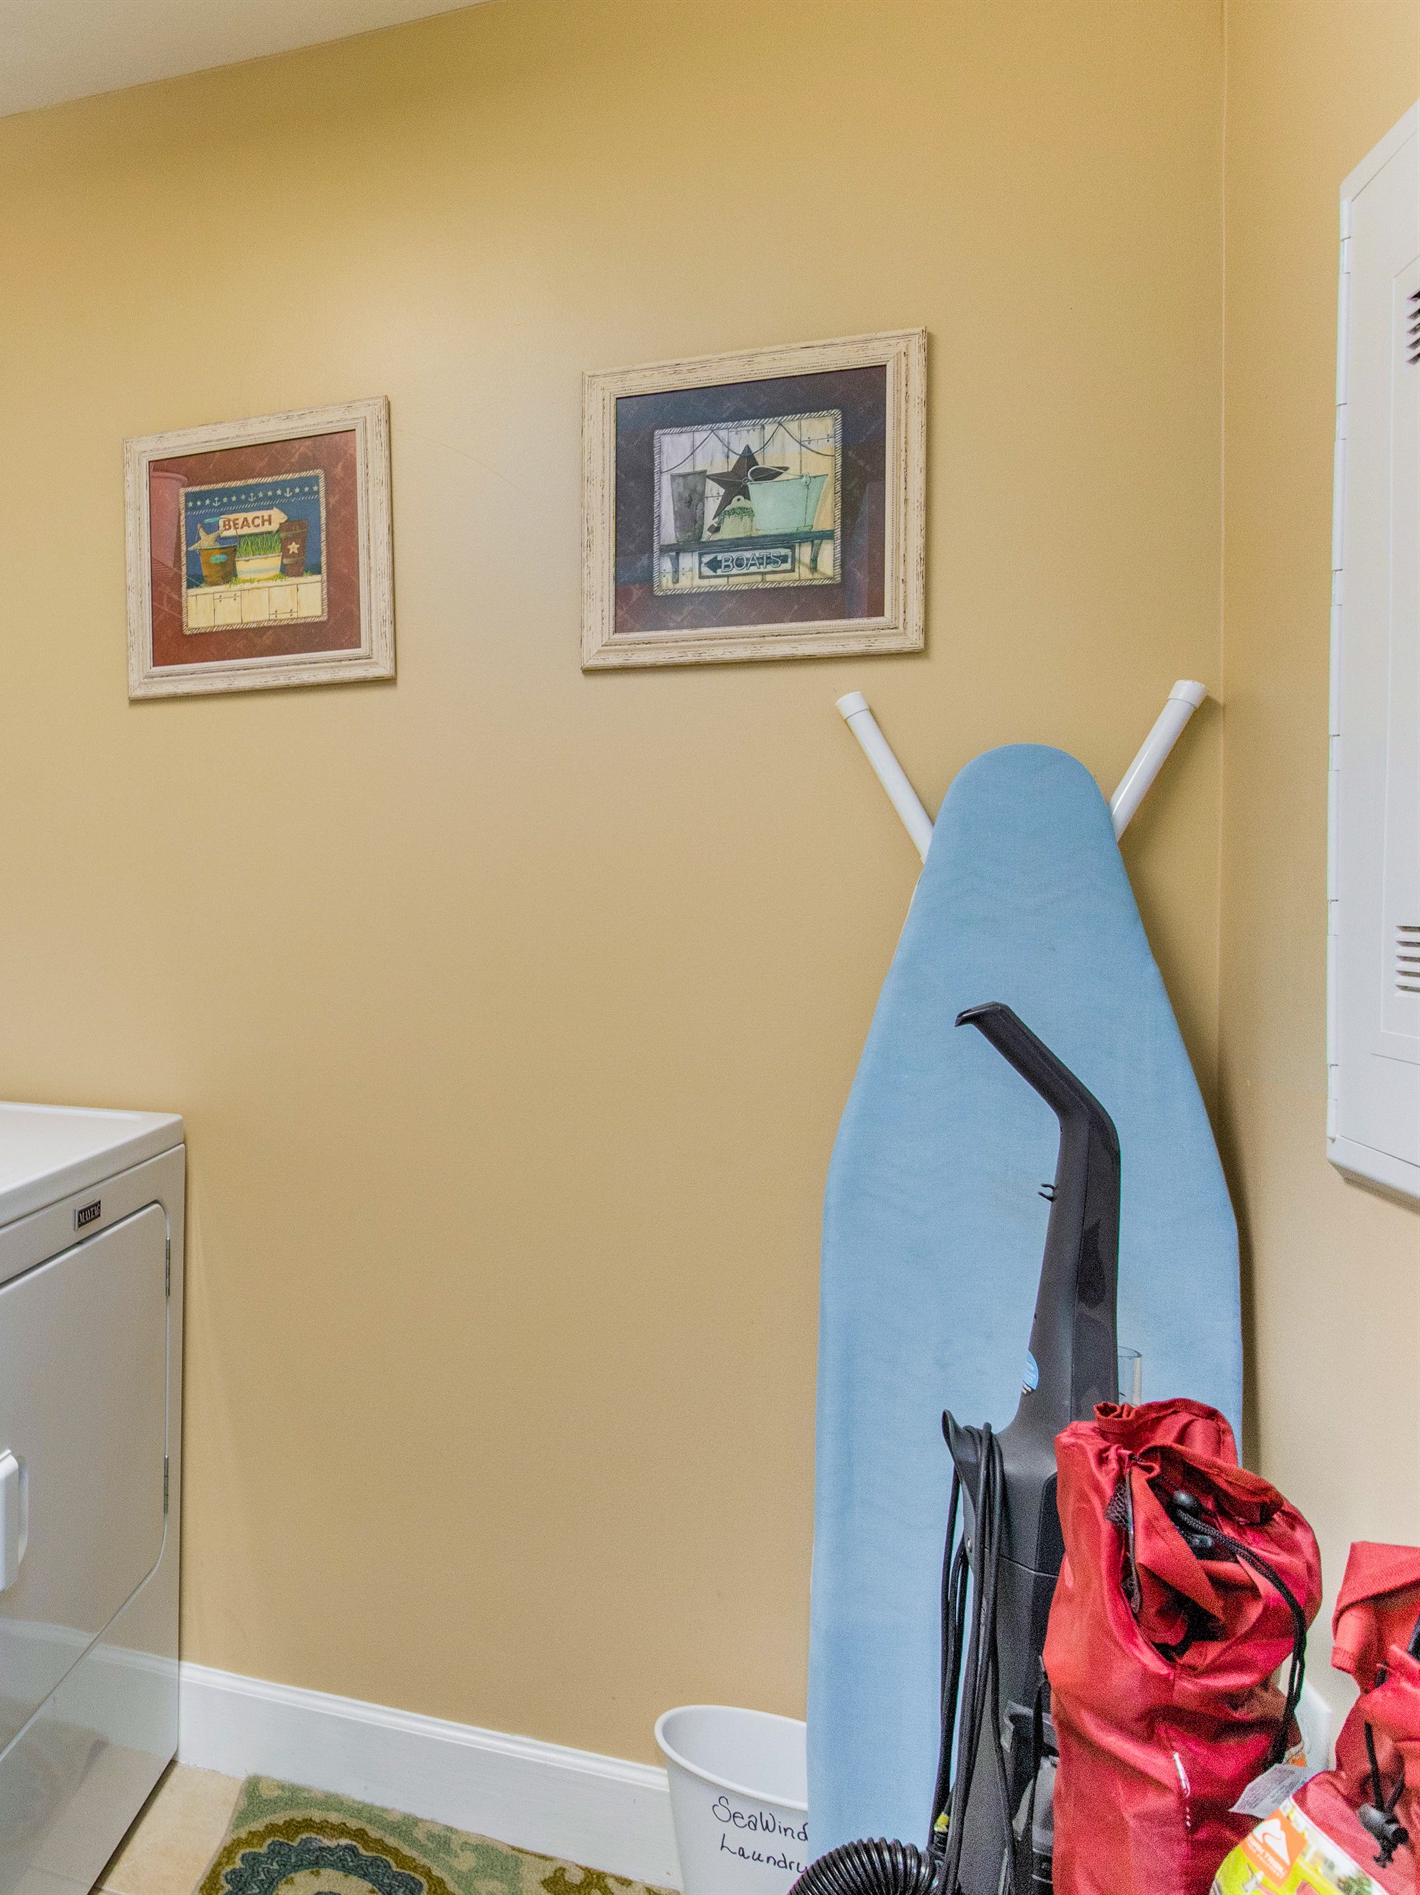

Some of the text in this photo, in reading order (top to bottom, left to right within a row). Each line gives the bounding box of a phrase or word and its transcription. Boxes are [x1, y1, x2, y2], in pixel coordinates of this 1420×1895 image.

[222, 513, 272, 532] BEACH
[720, 550, 782, 573] BOATS
[711, 1795, 809, 1842] SeaWind
